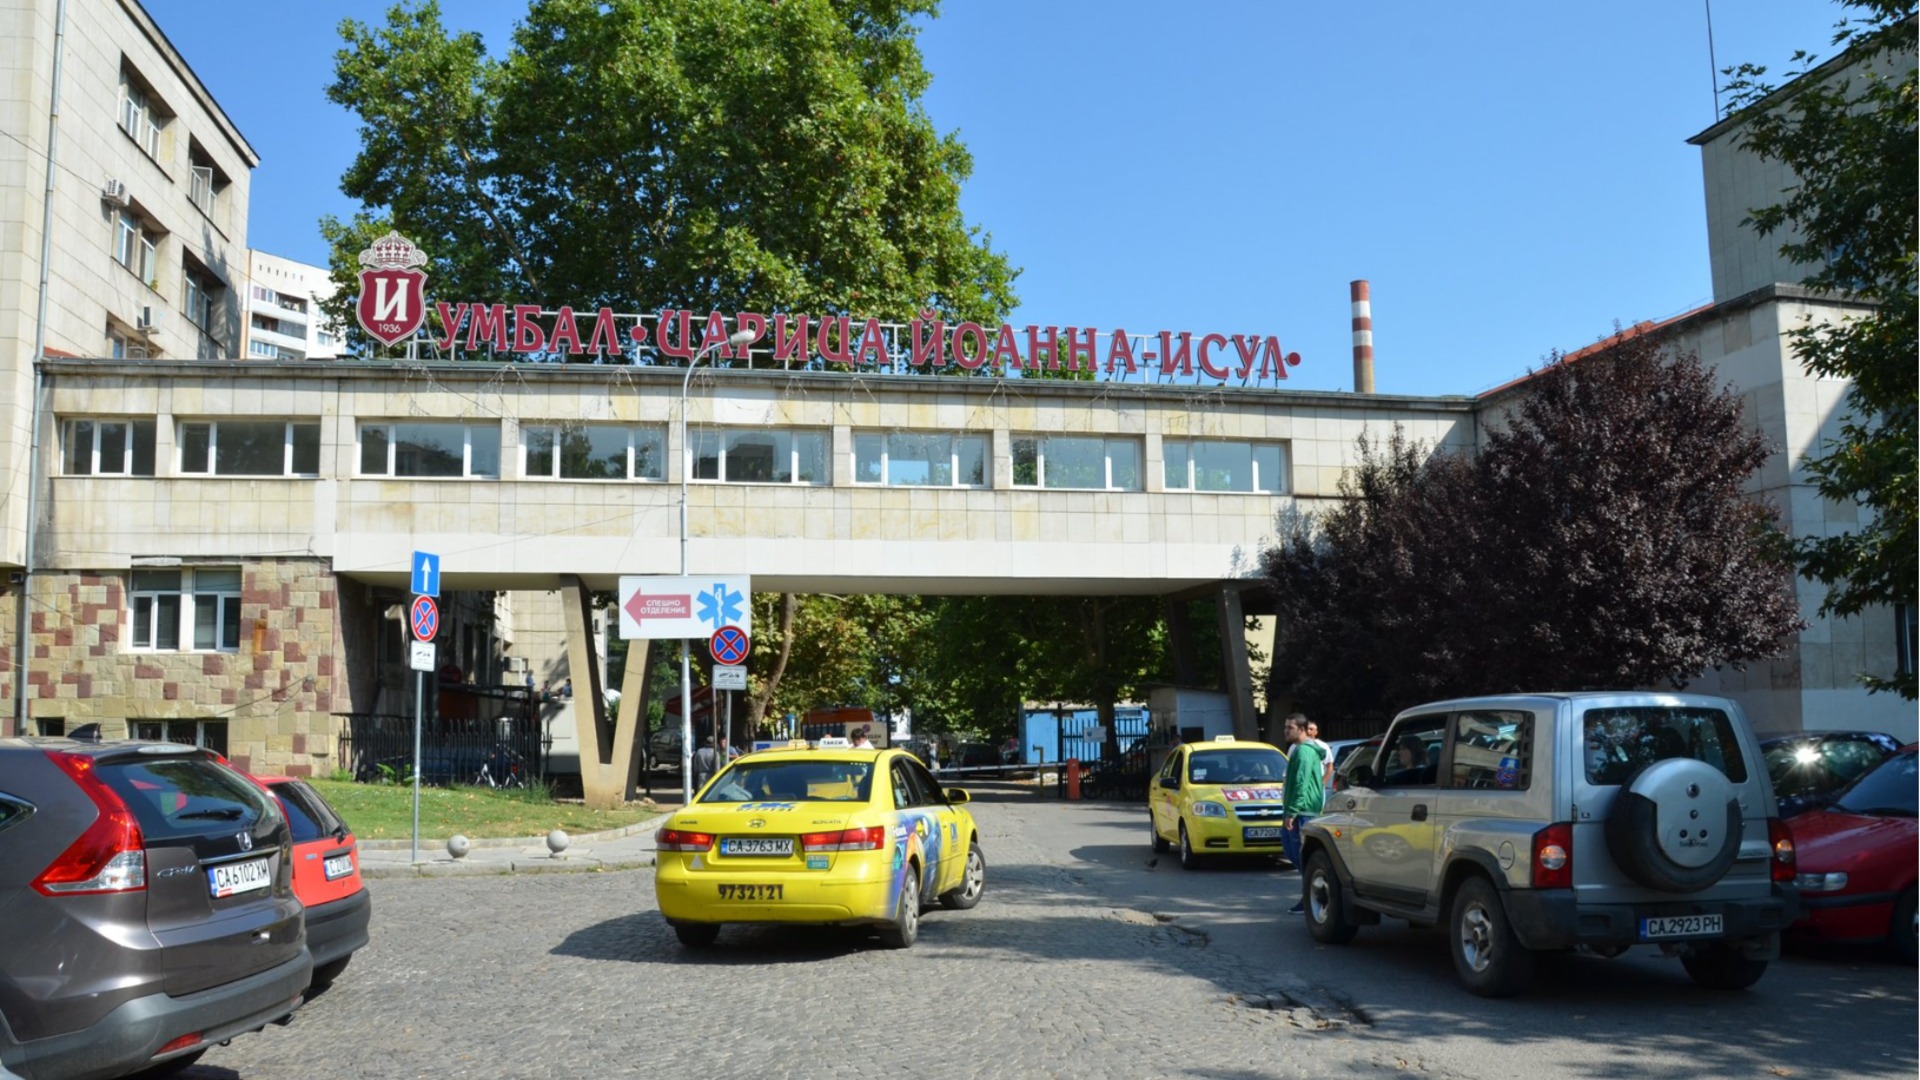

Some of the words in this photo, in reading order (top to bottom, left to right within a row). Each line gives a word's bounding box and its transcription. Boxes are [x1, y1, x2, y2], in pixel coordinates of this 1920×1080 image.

[373, 277, 410, 321] И
[377, 322, 402, 334] 1936
[435, 302, 622, 355] УМБАЛ
[656, 309, 890, 368] ЦАРИЦА
[640, 607, 687, 615] ОТДЕЛЕНИЕ
